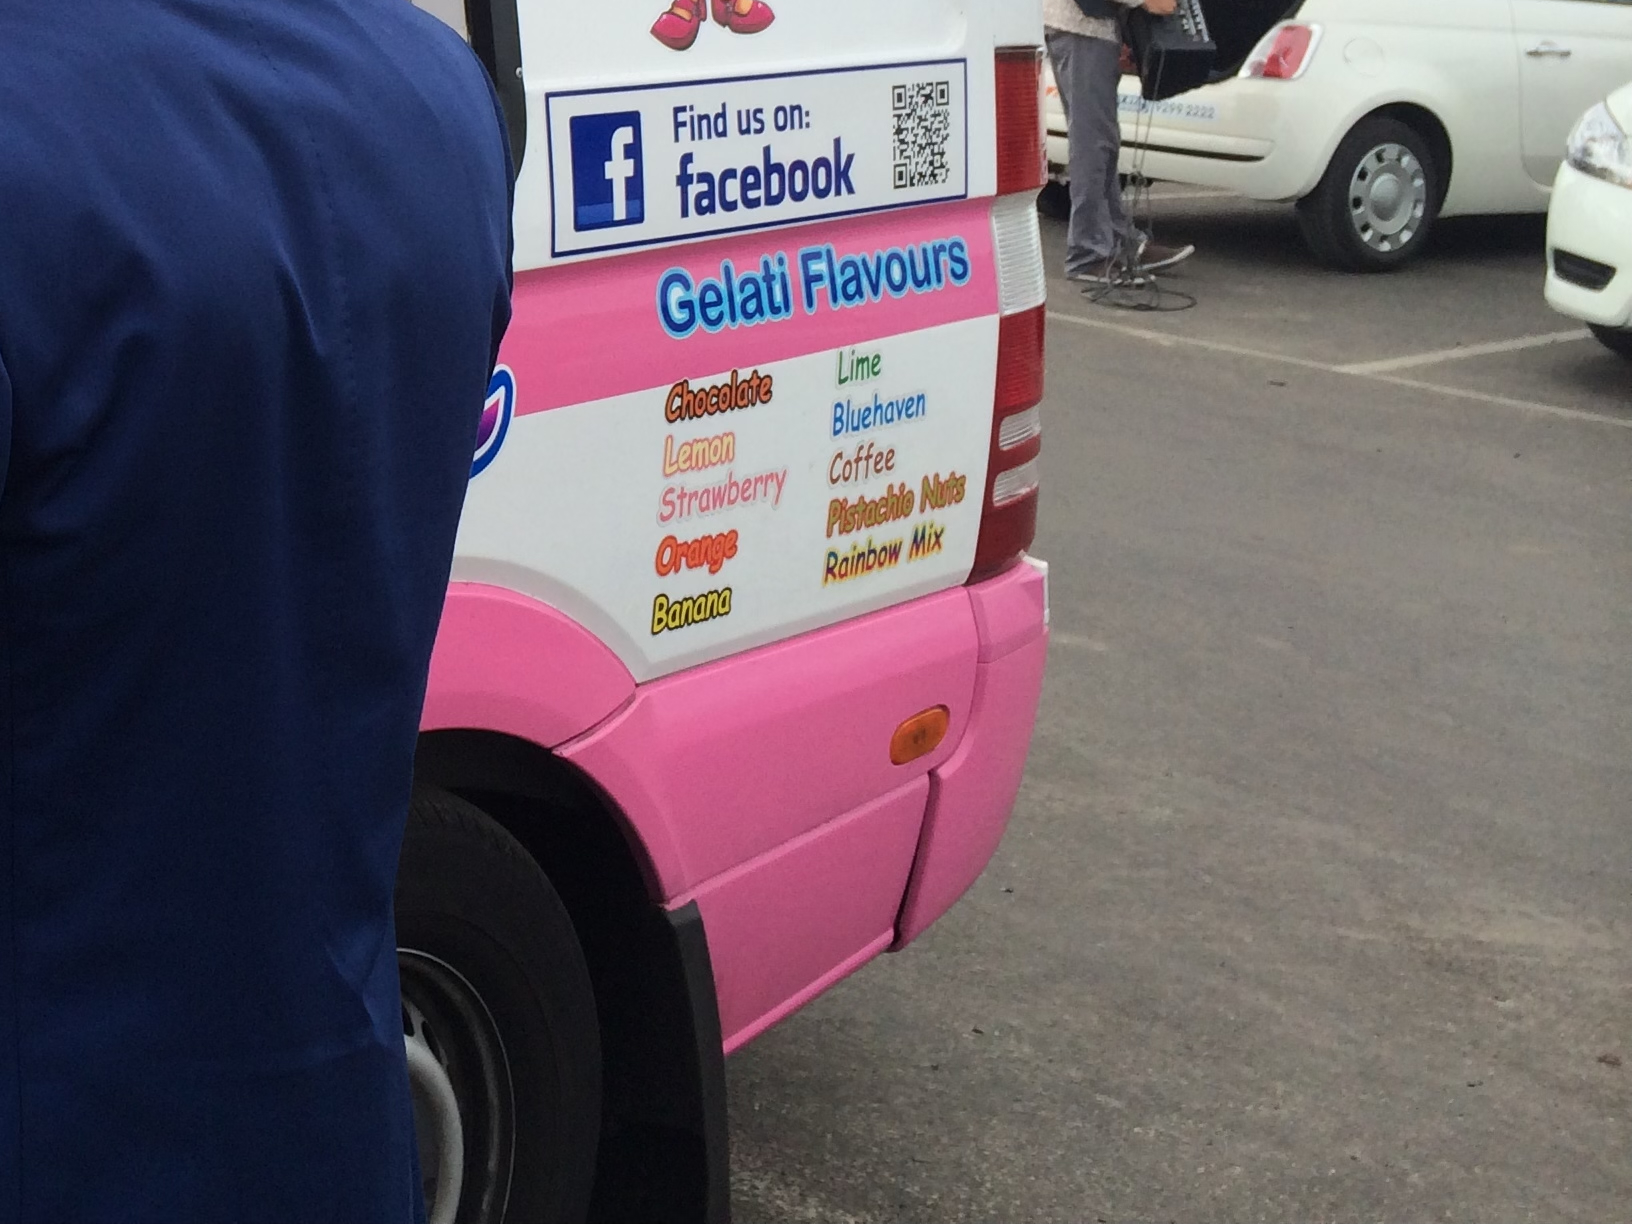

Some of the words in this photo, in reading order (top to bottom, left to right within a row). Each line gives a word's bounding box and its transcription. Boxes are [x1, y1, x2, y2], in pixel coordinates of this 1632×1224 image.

[672, 103, 728, 143] Find
[736, 103, 766, 135] us
[773, 104, 811, 131] on:
[676, 136, 857, 219] facebook
[657, 251, 794, 339] Gelati
[800, 236, 970, 315] Flavours
[837, 350, 882, 385] Lime
[665, 369, 773, 424] Chocolate
[832, 393, 926, 437] Bluehaven
[662, 432, 736, 477] Lemon
[829, 442, 895, 485] Coffee
[659, 470, 788, 523] Strawberry
[826, 481, 915, 539] Pistachio
[920, 470, 967, 515] Nuts
[655, 529, 739, 577] Orange
[822, 537, 903, 585] Rainbow
[908, 523, 945, 561] Mix
[650, 587, 732, 635] Banana
